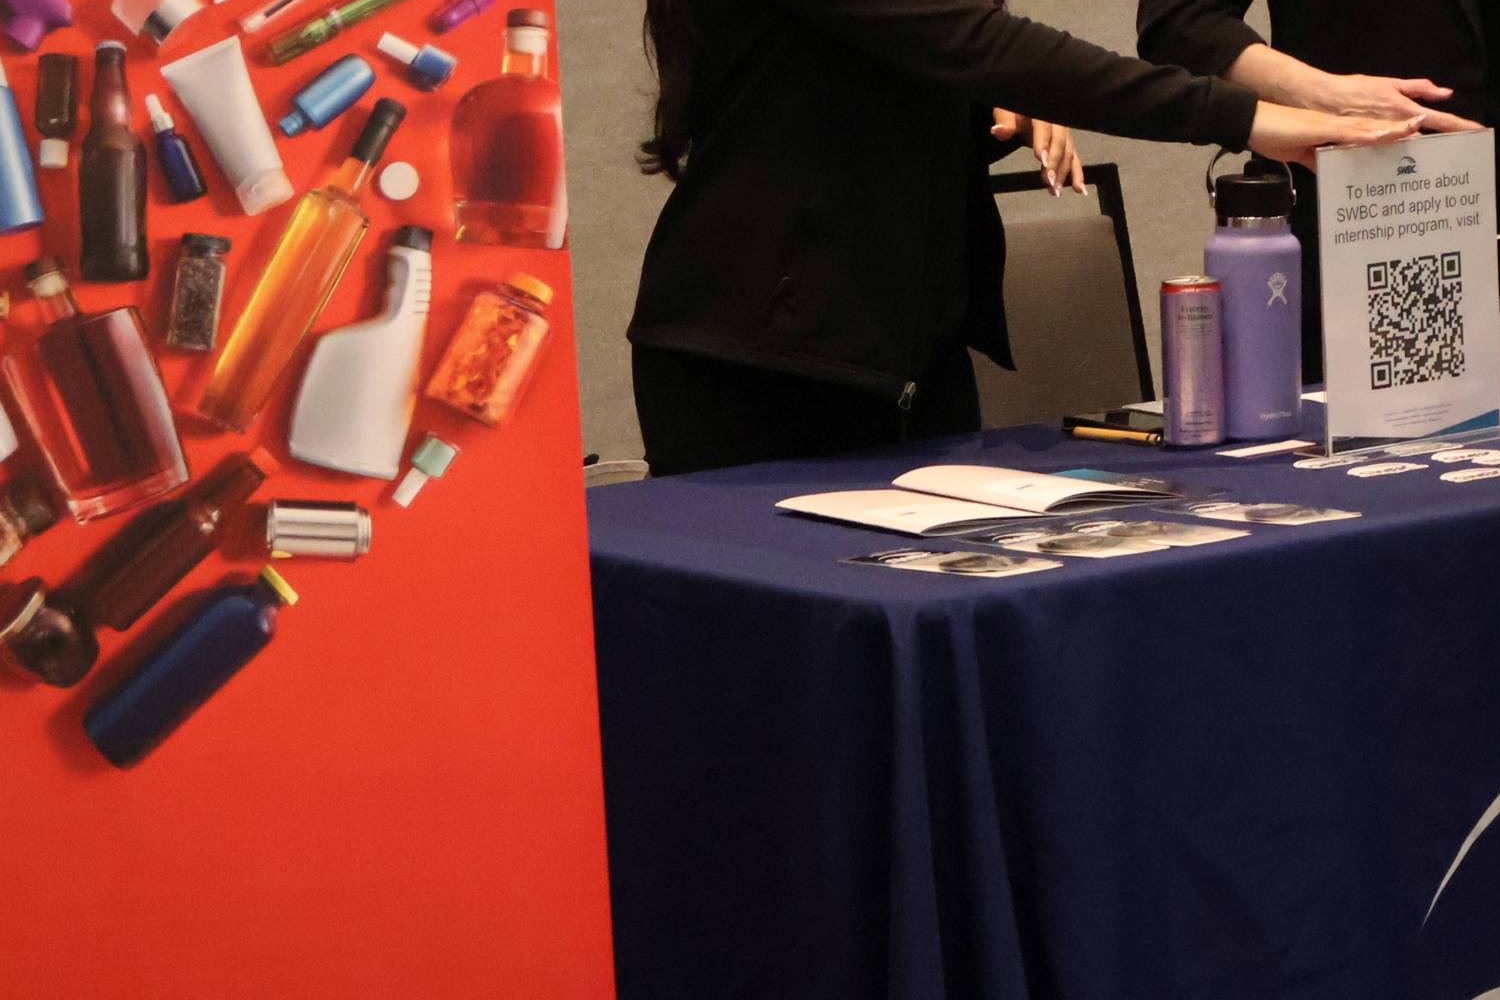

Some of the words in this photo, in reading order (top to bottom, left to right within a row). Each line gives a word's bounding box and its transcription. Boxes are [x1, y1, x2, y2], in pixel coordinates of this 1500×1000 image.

[1397, 165, 1417, 176] SWBC
[1346, 184, 1363, 200] To
[1367, 183, 1396, 197] learn
[1401, 179, 1431, 192] more
[1435, 171, 1469, 188] about
[1336, 203, 1378, 223] SWBC
[1382, 200, 1405, 217] and
[1409, 196, 1441, 214] apply
[1446, 196, 1456, 208] to
[1460, 193, 1480, 206] our
[1334, 221, 1394, 244] internship
[1398, 218, 1452, 238] program,
[1457, 212, 1480, 227] visit
